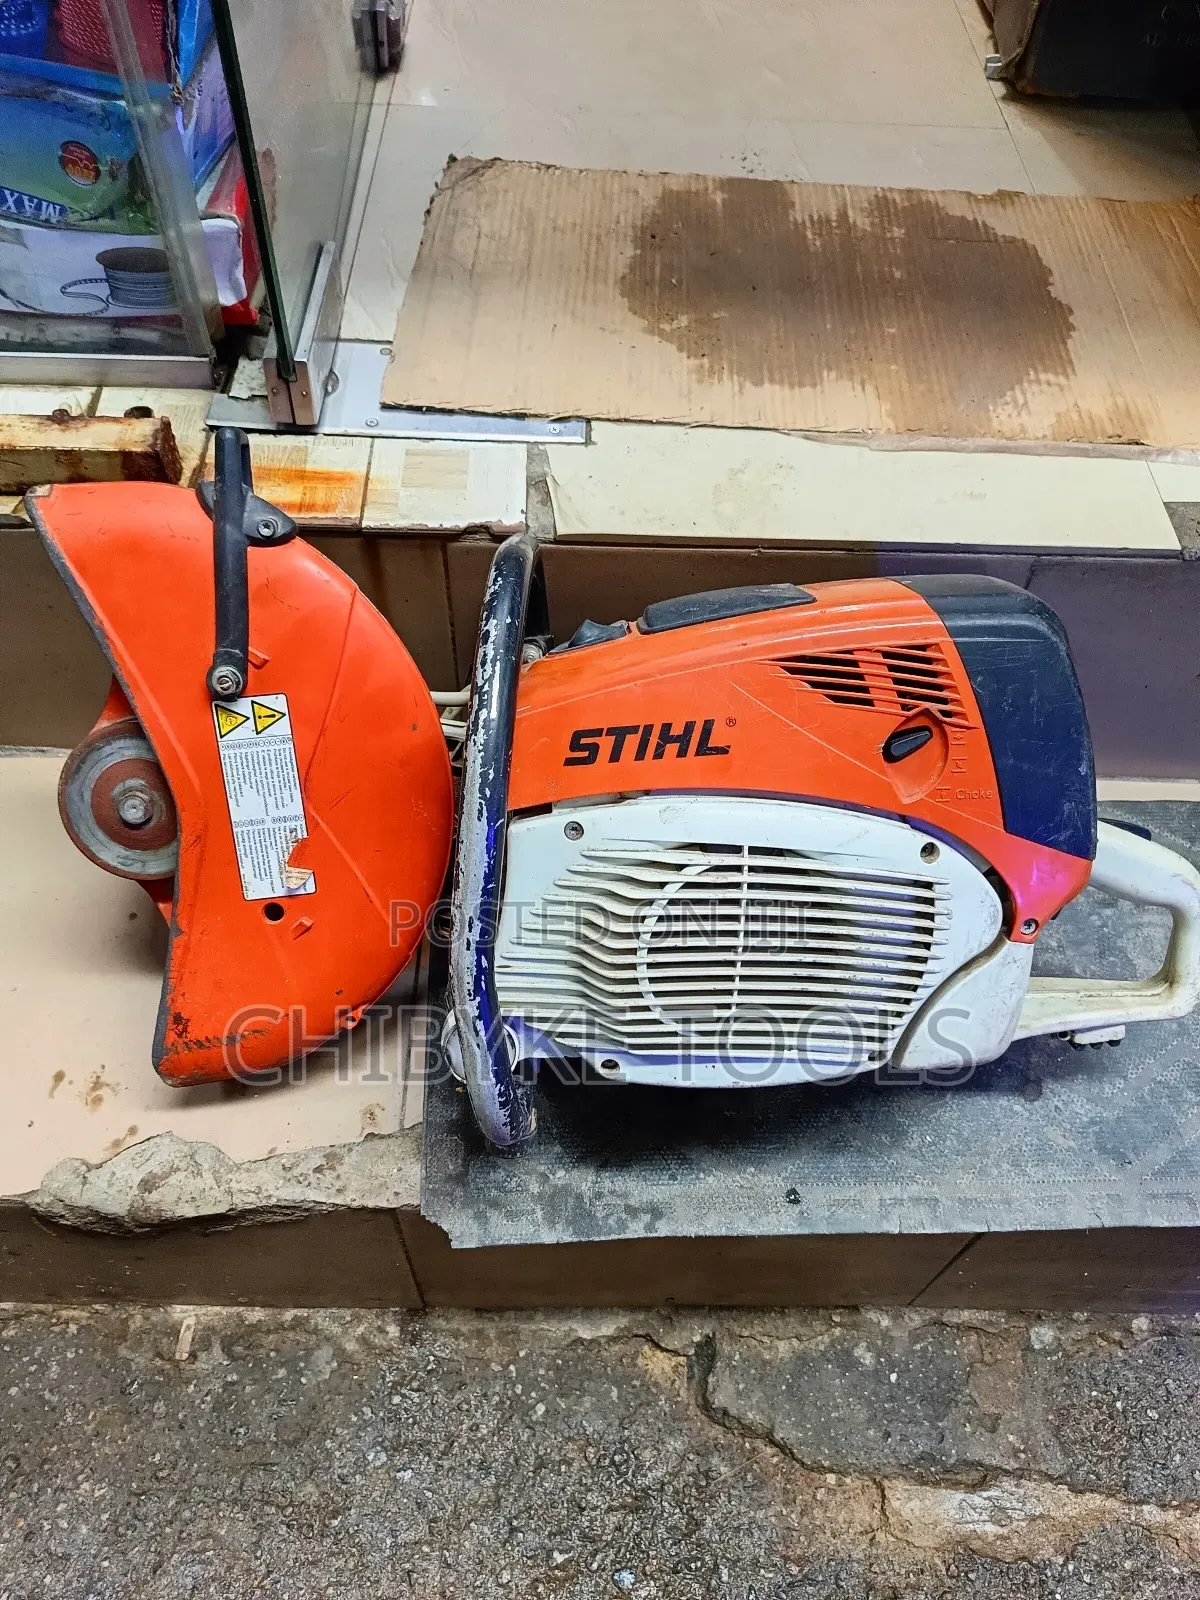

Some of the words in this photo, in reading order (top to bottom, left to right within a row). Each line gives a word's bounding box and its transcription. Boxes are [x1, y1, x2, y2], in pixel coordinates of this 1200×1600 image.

[1, 188, 61, 224] MAX
[563, 718, 731, 767] STIHL
[956, 788, 993, 800] Choke
